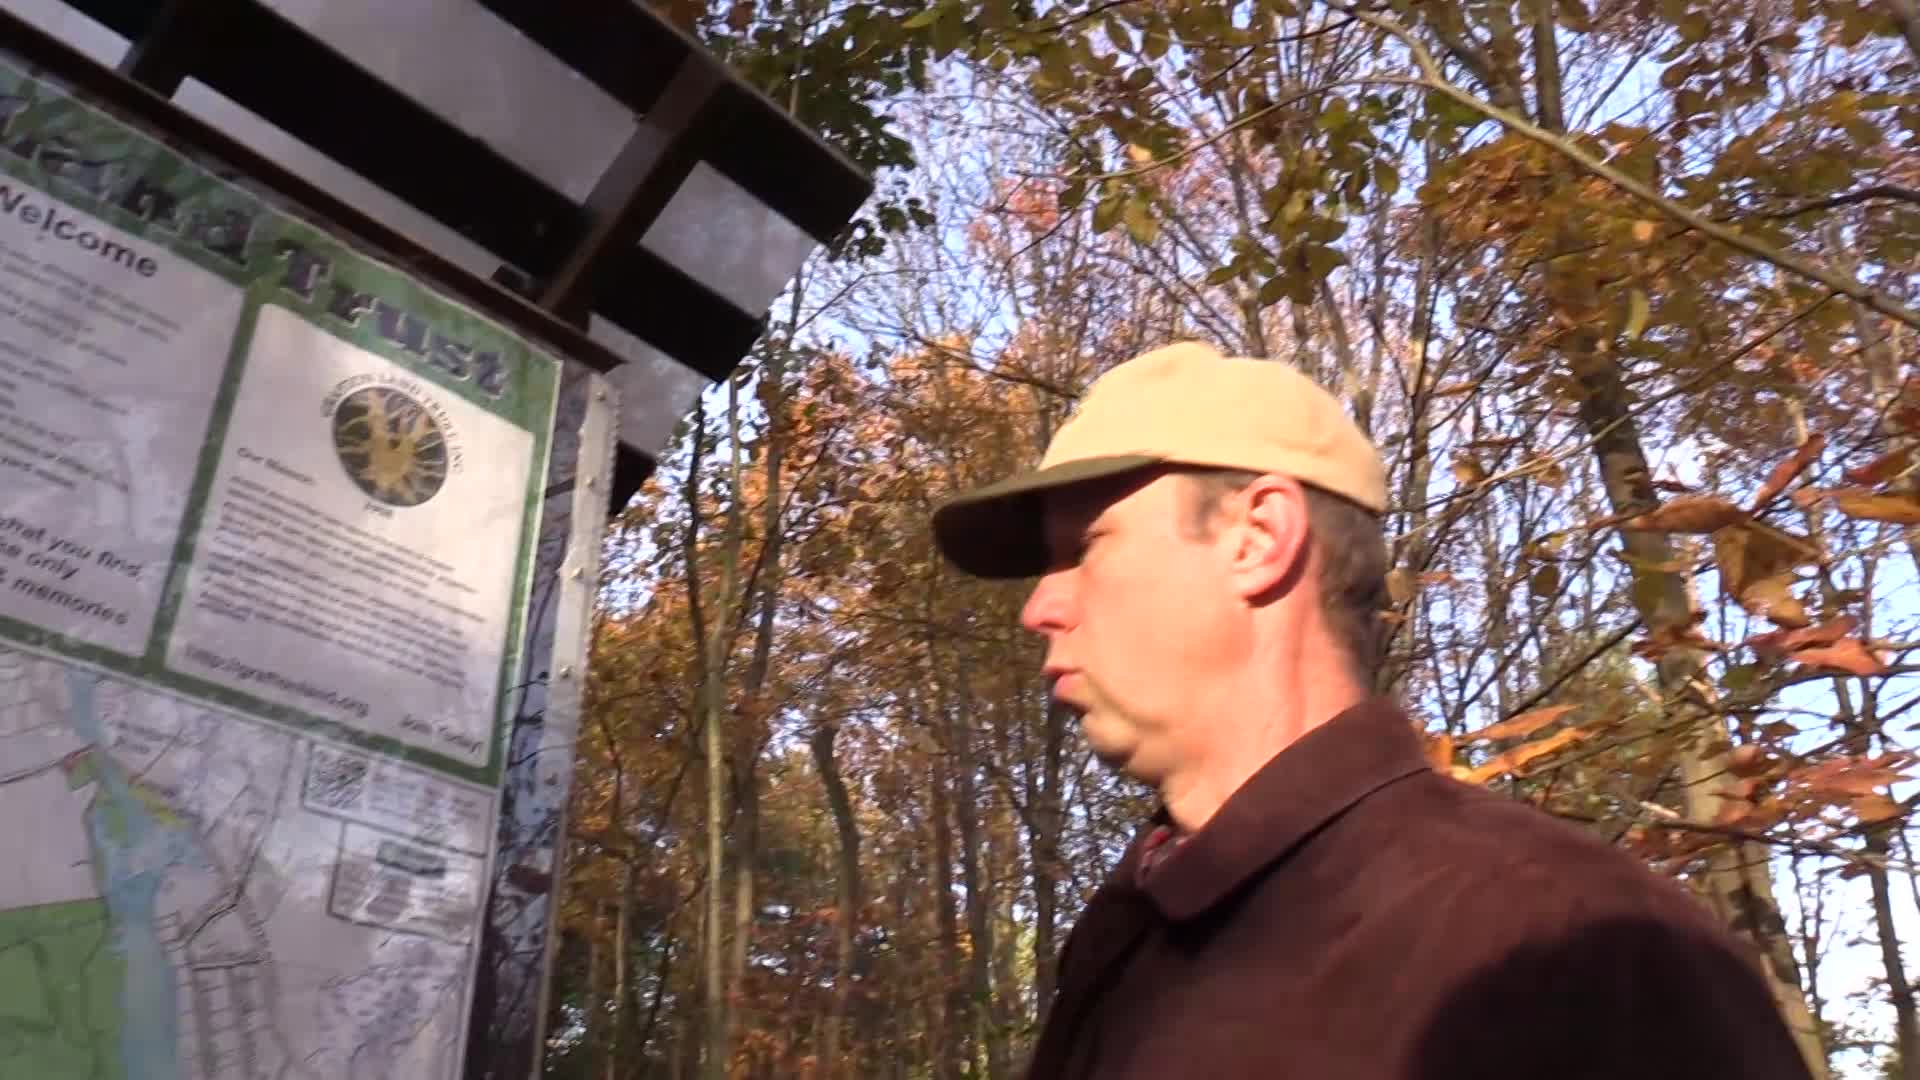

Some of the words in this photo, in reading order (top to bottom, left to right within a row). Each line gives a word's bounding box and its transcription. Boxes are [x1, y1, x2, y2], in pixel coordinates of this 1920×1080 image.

[0, 185, 158, 278] Welcome
[273, 237, 509, 398] Trust
[48, 537, 92, 561] you
[11, 578, 129, 626] memories
